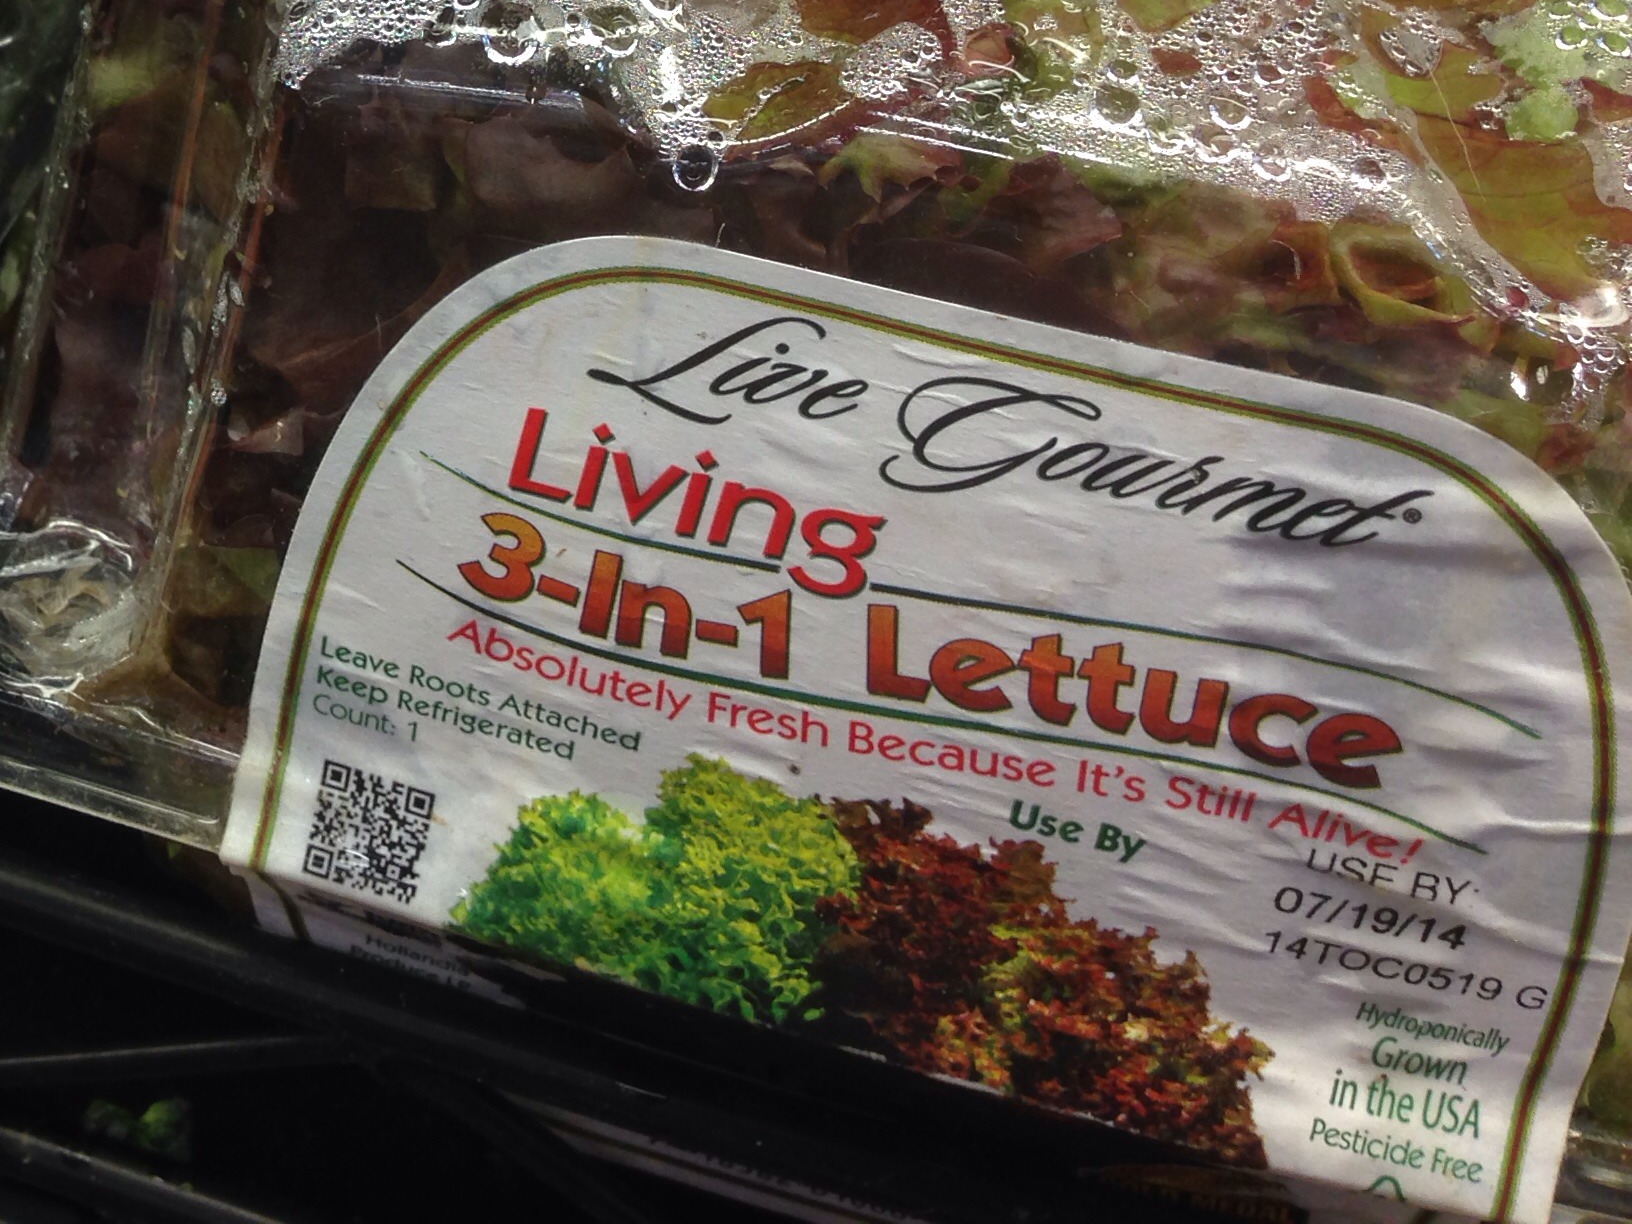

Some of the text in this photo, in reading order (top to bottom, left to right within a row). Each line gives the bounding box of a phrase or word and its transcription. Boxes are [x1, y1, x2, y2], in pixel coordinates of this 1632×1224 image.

[587, 316, 1432, 549] Live Gourmet
[506, 405, 889, 599] Living
[455, 510, 1407, 789] 3-In-1 Lettuce
[312, 693, 419, 742] Count: 1
[316, 665, 576, 761] Keep Refrigerated
[320, 635, 643, 752] Leave Roots Attached
[447, 619, 1425, 864] Absolutely Fresh Because It's Still Alive!
[1008, 799, 1147, 863] Use By
[1306, 848, 1399, 887] USE
[1273, 886, 1469, 950] 07/19/14
[1266, 931, 1548, 1009] 14TOC0519 G
[1355, 1001, 1511, 1058] Hydroponically
[1370, 1035, 1469, 1086] Grown
[1328, 1068, 1481, 1140] in the USA
[1309, 1117, 1484, 1184] Pesticide Free
